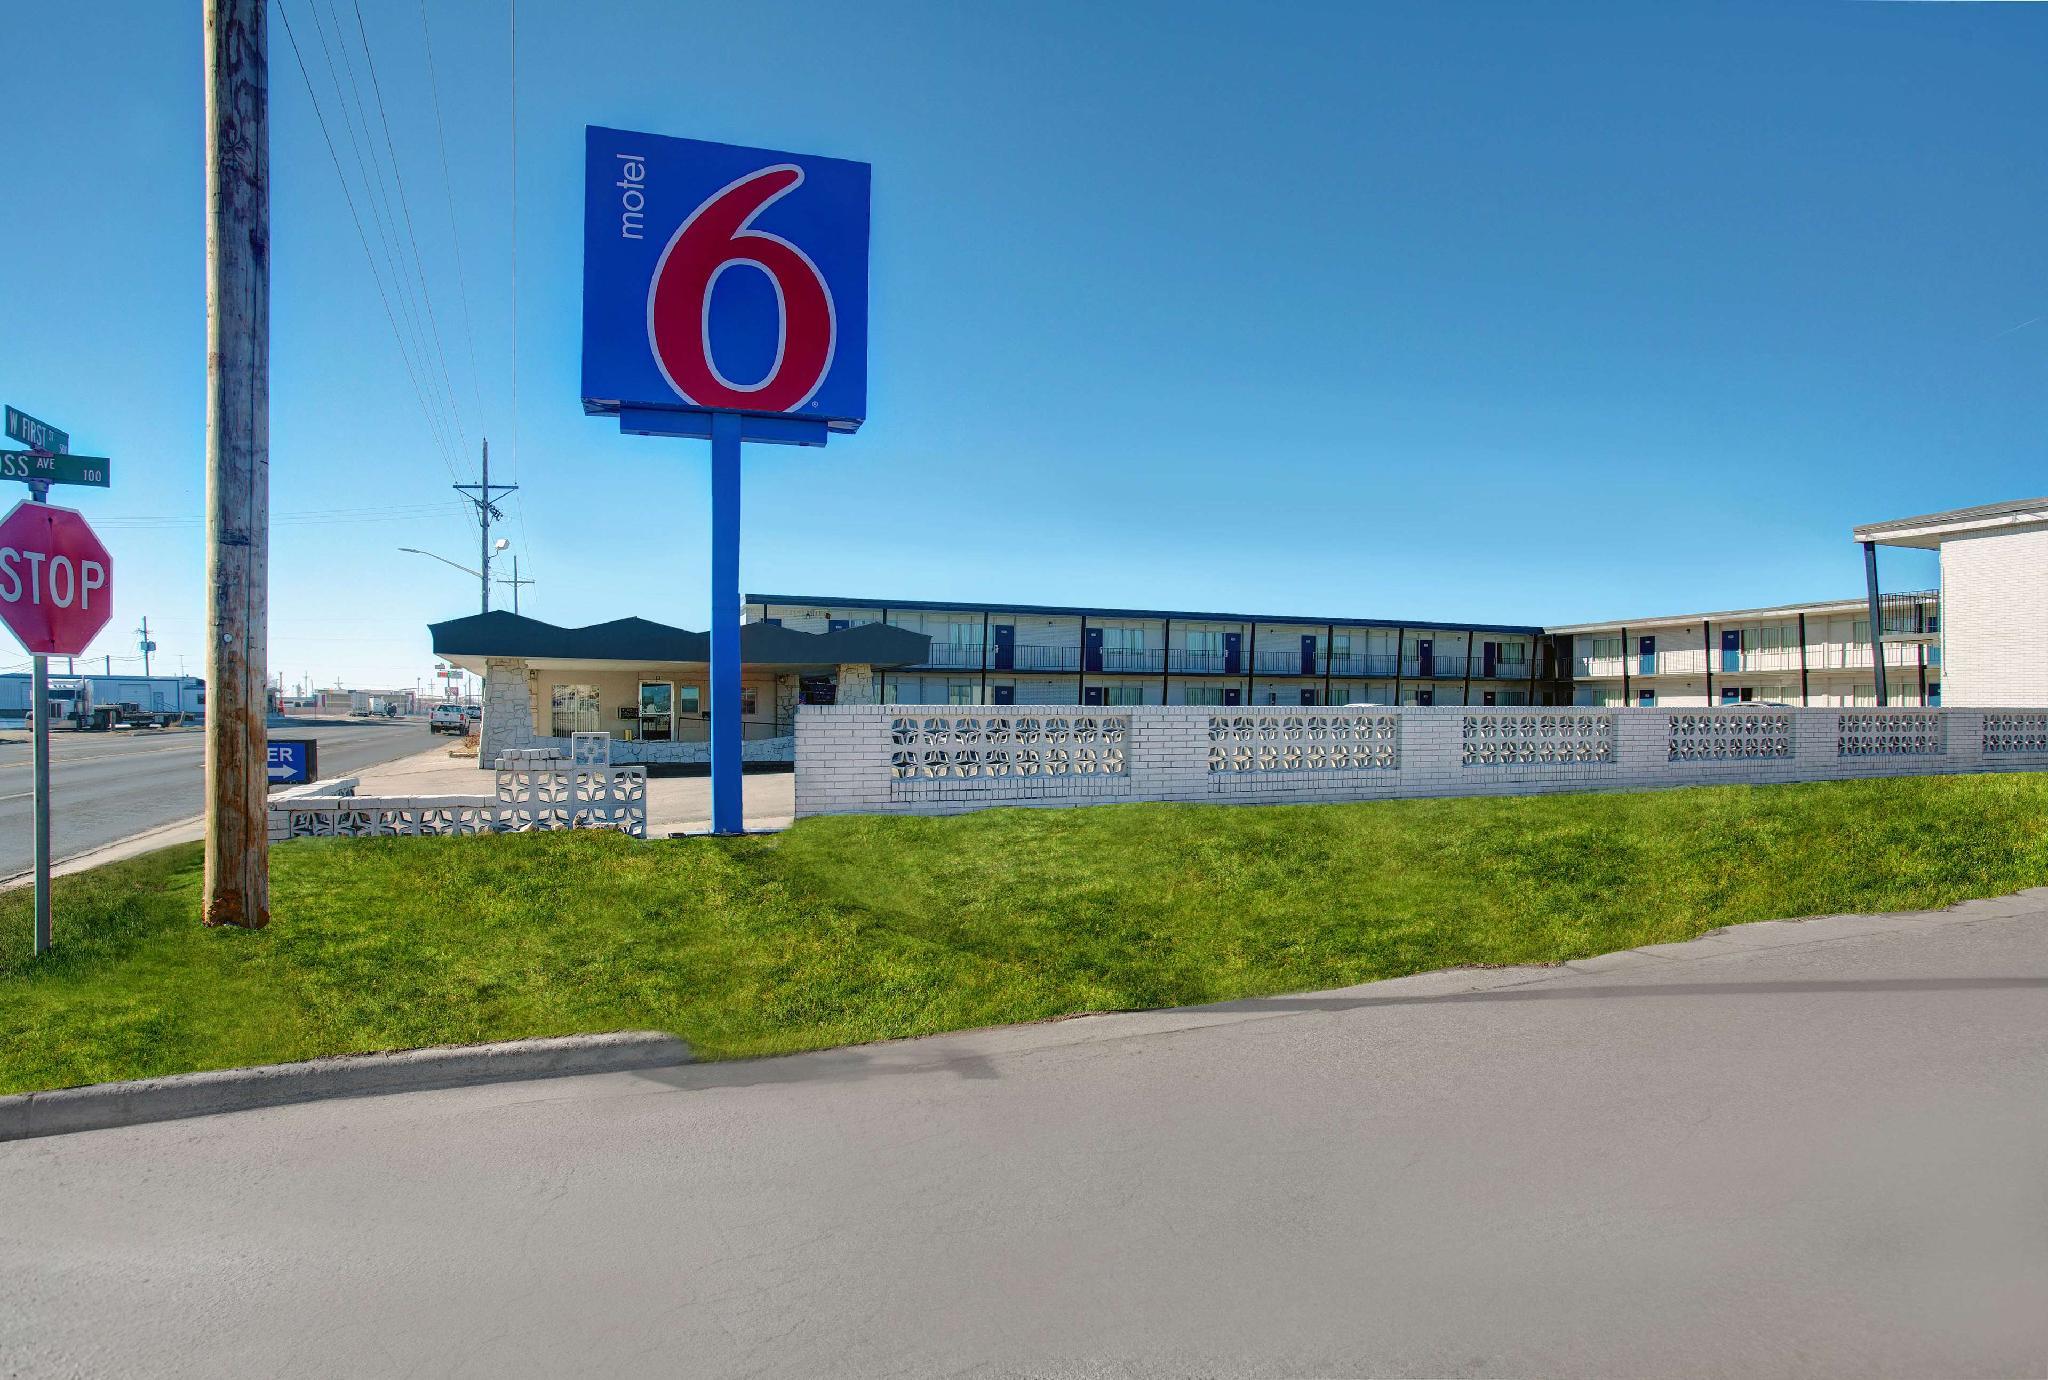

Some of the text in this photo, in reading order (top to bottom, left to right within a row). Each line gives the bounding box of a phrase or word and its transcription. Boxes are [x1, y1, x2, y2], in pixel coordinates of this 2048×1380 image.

[616, 153, 645, 240] motel
[646, 163, 838, 413] 6
[9, 410, 54, 449] W FIRST ST
[0, 454, 55, 477] SS AVE
[83, 470, 102, 482] 100
[0, 546, 105, 610] STOP
